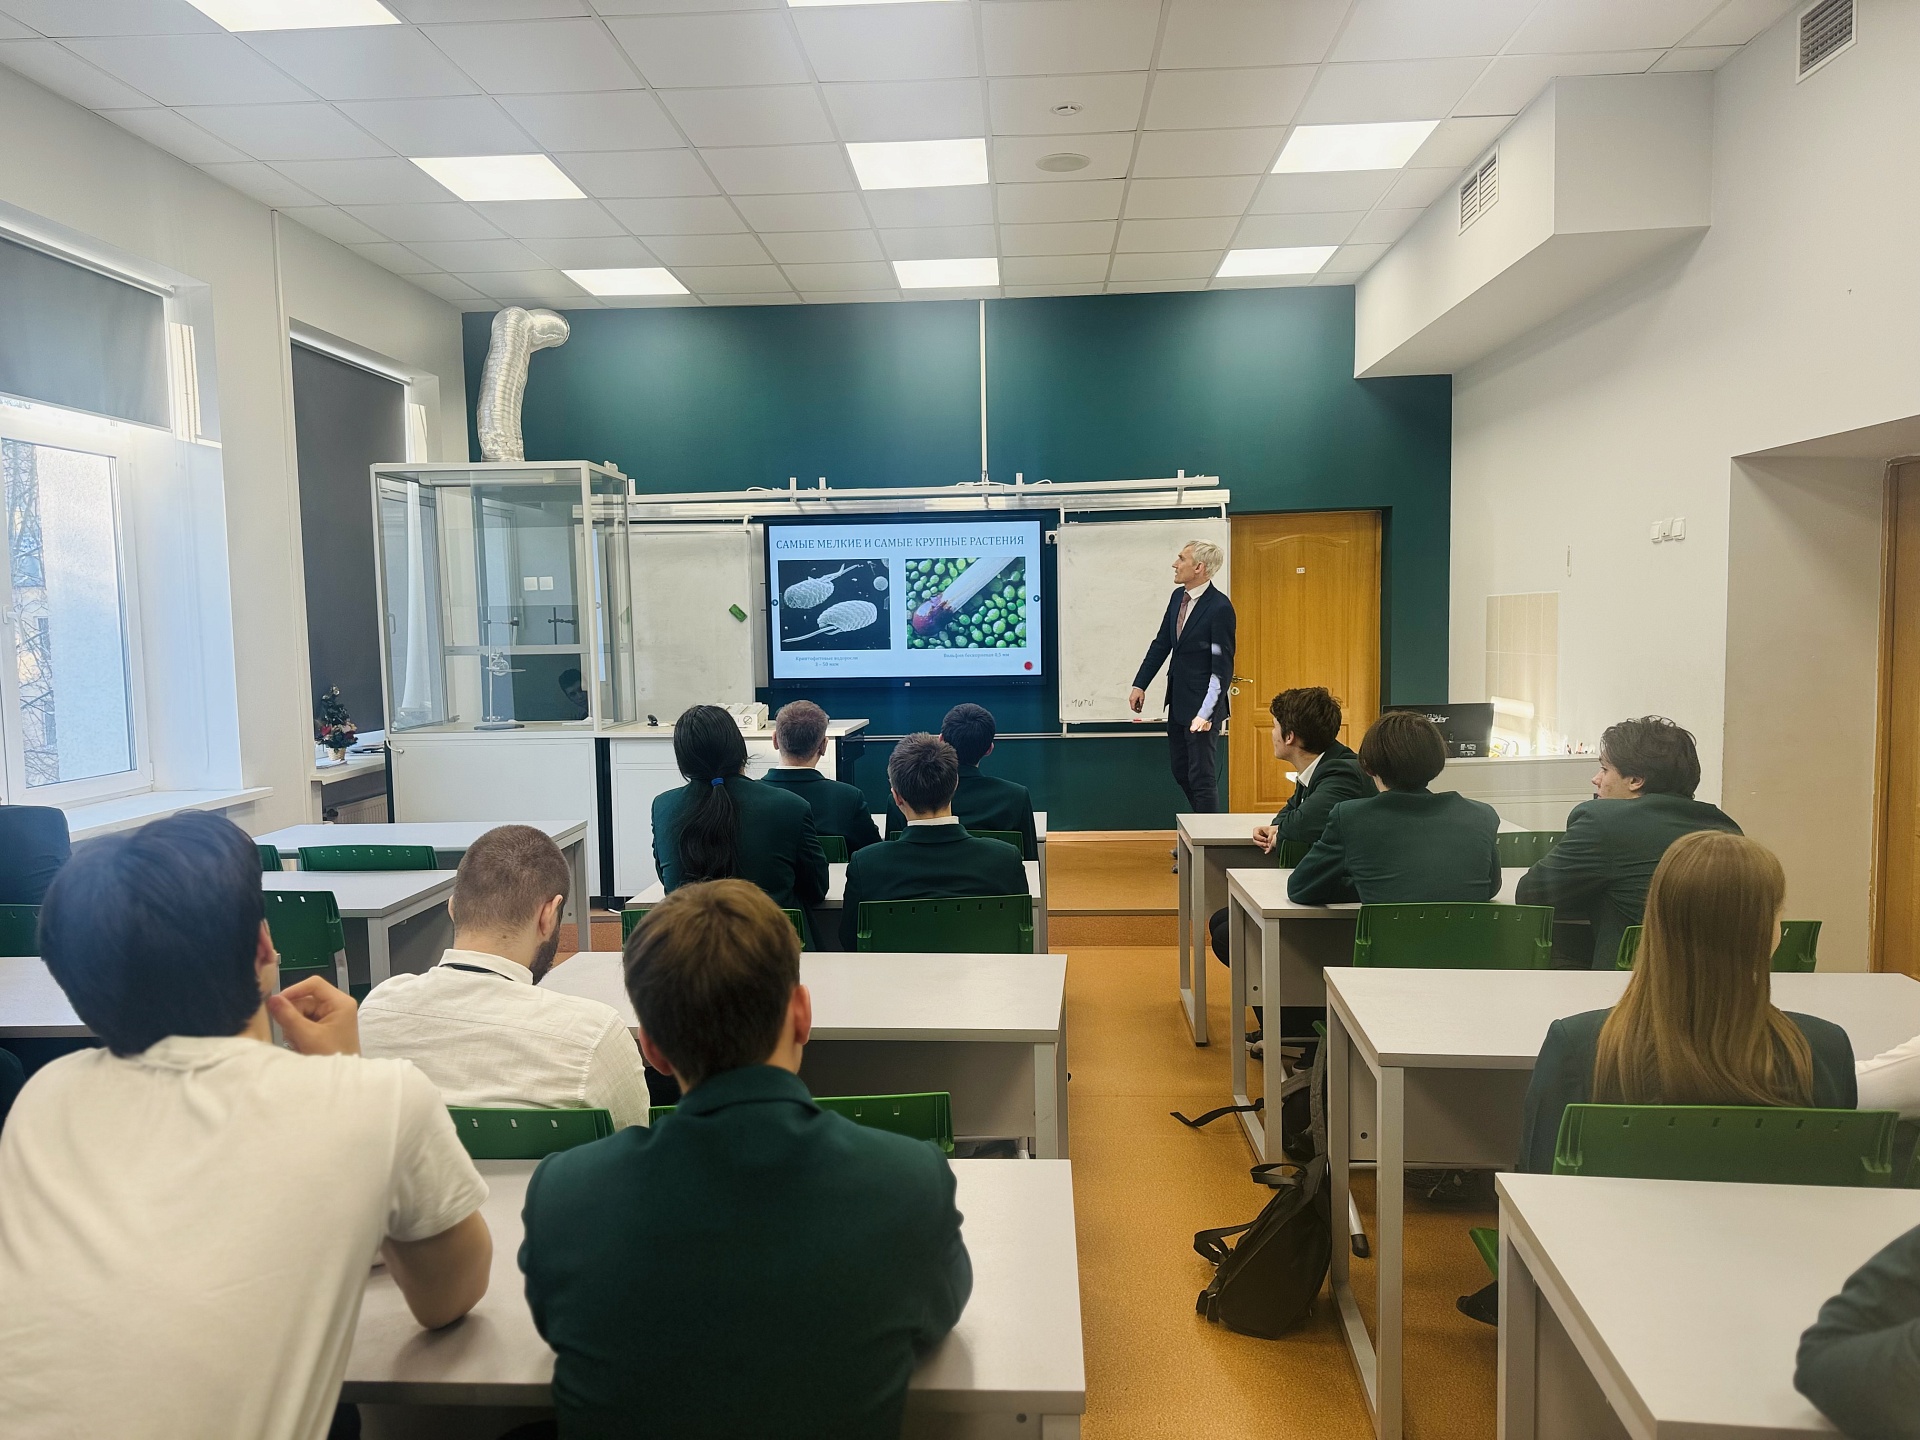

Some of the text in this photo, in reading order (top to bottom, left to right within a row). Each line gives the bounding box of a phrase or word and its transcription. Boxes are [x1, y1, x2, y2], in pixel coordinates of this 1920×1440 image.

[776, 535, 1024, 549] САМЫЕ МЕЛКИЕ И САМЫЕ КРУПНЫЕ РАСТЕНИЯ
